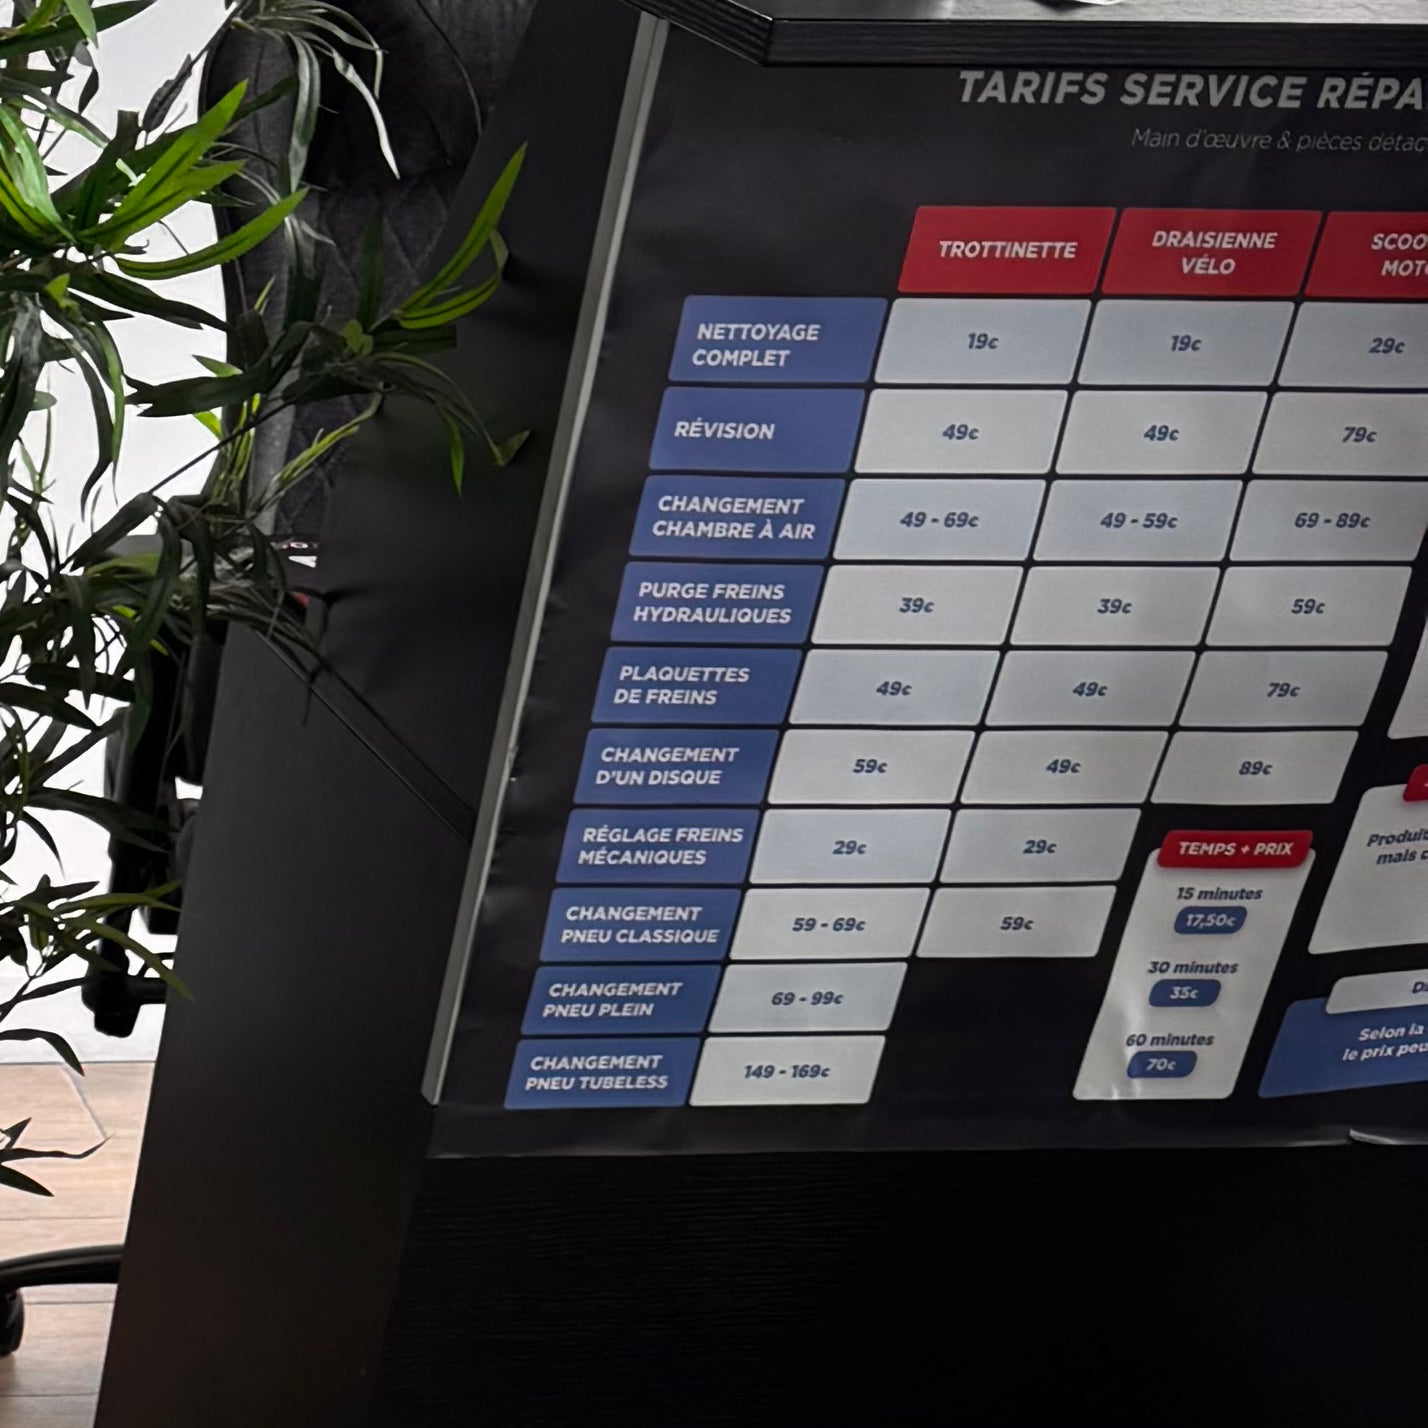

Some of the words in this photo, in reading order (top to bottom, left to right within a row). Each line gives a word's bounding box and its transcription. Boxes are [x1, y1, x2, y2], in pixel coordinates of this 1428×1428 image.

[959, 70, 1108, 105] TARIFS
[1120, 72, 1307, 109] SERVICE
[1132, 128, 1178, 147] Main
[1277, 131, 1293, 150] &
[1296, 130, 1363, 153] pièces
[1152, 230, 1278, 250] DRAISIENNE
[939, 240, 1078, 259] TROTTINETTE
[1181, 253, 1236, 276] VÉLO
[1381, 260, 1428, 277] MOT
[697, 323, 820, 341] NETTOYAGE
[692, 349, 790, 367] COMPLET
[674, 417, 775, 440] RÉVISION
[658, 496, 804, 514] CHANGEMENT
[652, 520, 755, 539] CHAMBRE
[758, 518, 774, 539] À
[778, 523, 816, 539] AIR
[900, 511, 927, 529] 49
[1100, 512, 1127, 529] 49
[1294, 512, 1319, 529] 69
[639, 581, 709, 599] PURGE
[713, 583, 785, 600] FREINS
[633, 606, 792, 624] HYDRAULIQUES
[619, 665, 750, 682] PLAQUETTES
[613, 689, 642, 704] DE
[645, 689, 717, 705] FREINS
[601, 747, 739, 763] CHANGEMENT
[596, 770, 644, 785] D'UN
[648, 770, 722, 785] DISQUE
[583, 824, 671, 842] RÉGLAGE
[675, 827, 744, 842] FREINS
[578, 846, 706, 865] MÉCANIQUES
[1179, 841, 1236, 856] TEMPS
[1254, 841, 1295, 856] PRIX
[1376, 849, 1417, 865] mais
[1177, 887, 1194, 900] 15
[1197, 887, 1263, 900] minutes
[566, 906, 702, 921] CHANGEMENT
[792, 917, 816, 932] 59
[561, 929, 612, 943] PNEU
[615, 929, 720, 943] CLASSIQUE
[1147, 961, 1170, 974] 30
[1173, 961, 1239, 974] minutes
[549, 982, 682, 998] CHANGEMENT
[771, 992, 796, 1006] 69
[543, 1004, 595, 1018] PNEU
[598, 1003, 654, 1017] PLEIN
[1126, 1034, 1147, 1047] 60
[1150, 1033, 1215, 1047] minutes
[1358, 1026, 1405, 1041] Selon
[1409, 1023, 1424, 1036] la
[1342, 1048, 1357, 1061] le
[1360, 1045, 1394, 1062] prix
[530, 1055, 663, 1071] CHANGEMENT
[744, 1064, 775, 1079] 149
[525, 1077, 574, 1091] PNEU
[580, 1075, 668, 1090] TUBELESS
